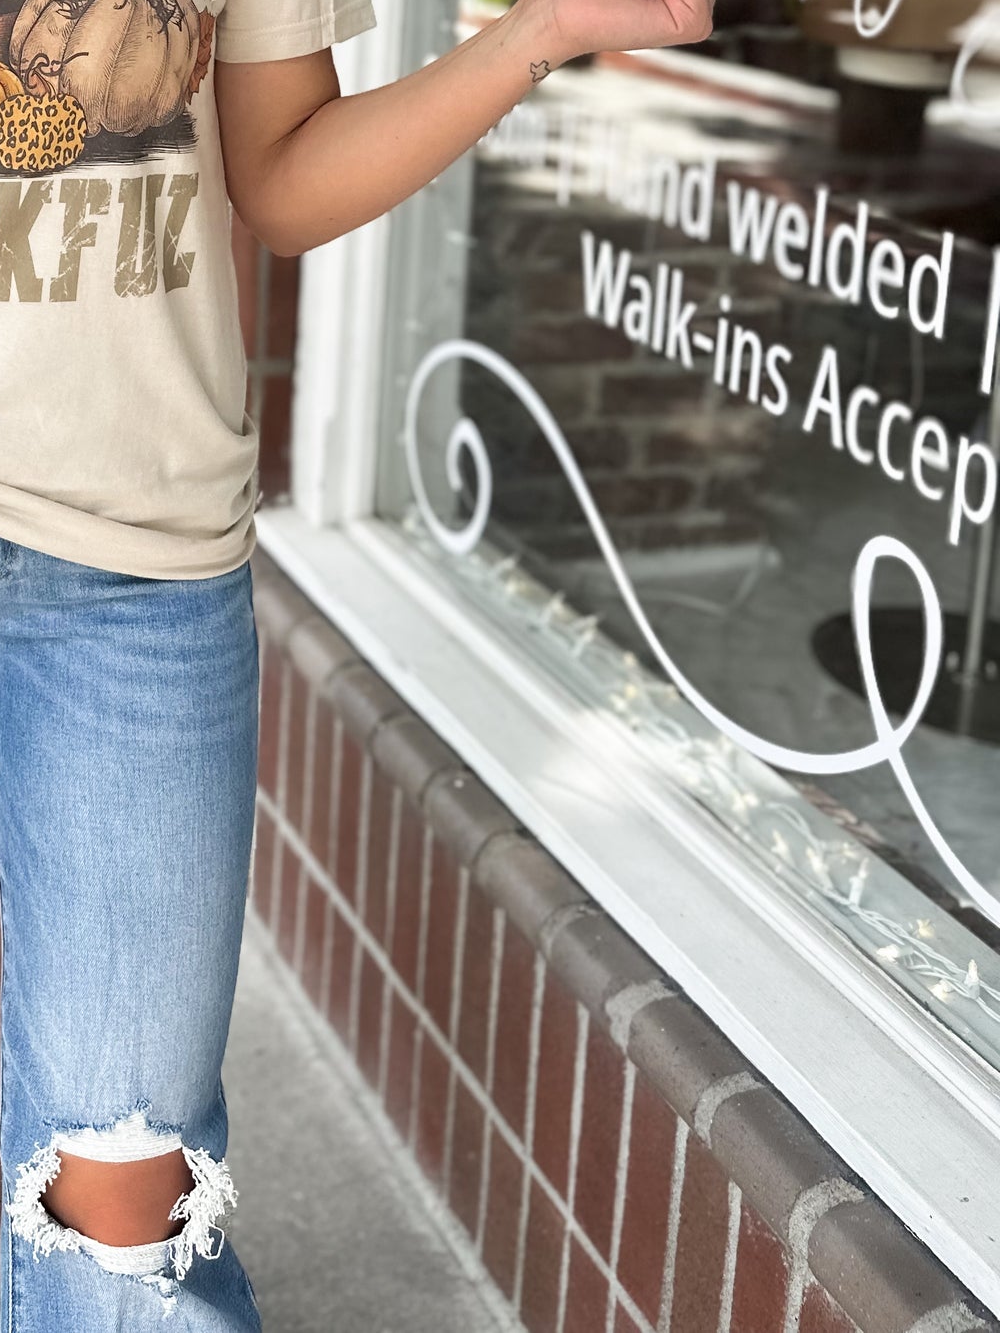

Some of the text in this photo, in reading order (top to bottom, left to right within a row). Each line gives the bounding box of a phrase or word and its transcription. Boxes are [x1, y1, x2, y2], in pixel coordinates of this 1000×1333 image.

[727, 177, 955, 339] welded
[579, 229, 999, 547] Walk-ins Accep
